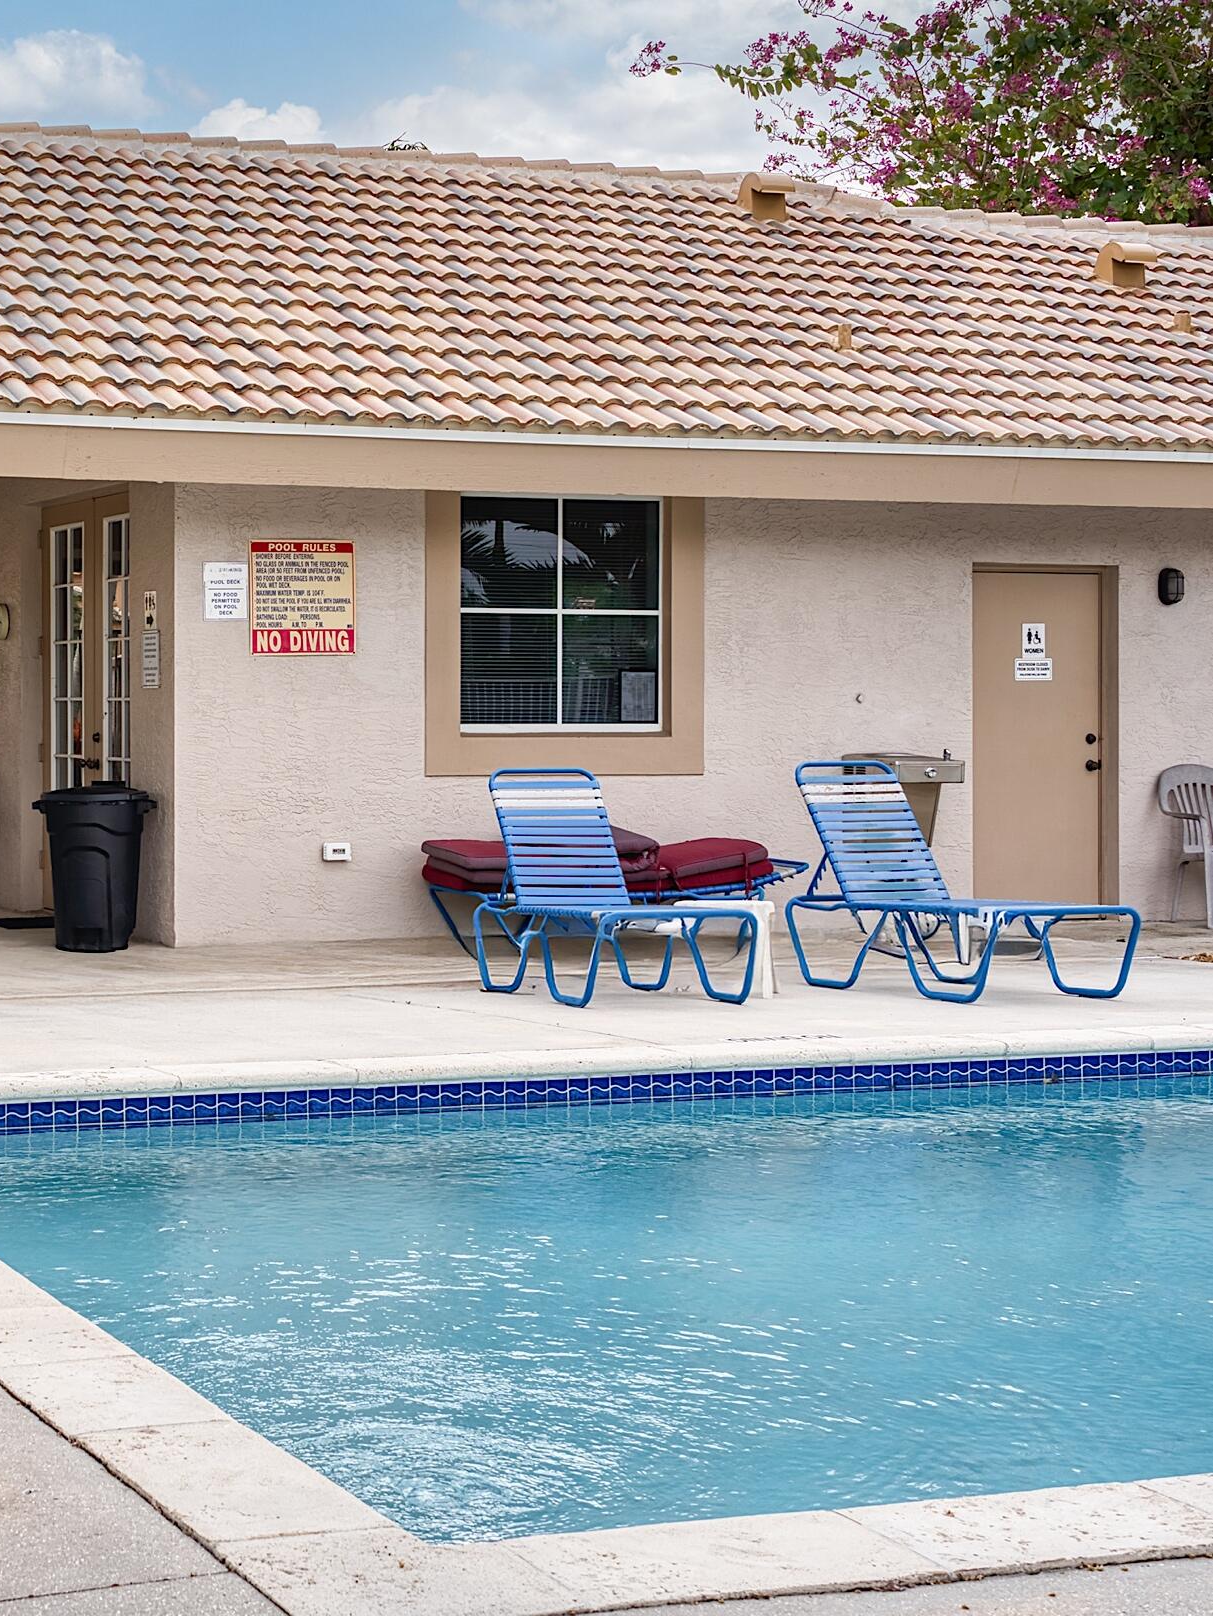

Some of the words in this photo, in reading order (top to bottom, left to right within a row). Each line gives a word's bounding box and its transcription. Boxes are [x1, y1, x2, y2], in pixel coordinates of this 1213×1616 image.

[268, 543, 297, 552] POOL
[302, 543, 336, 552] RULES
[257, 631, 282, 652] NO
[289, 631, 349, 652] DIVING
